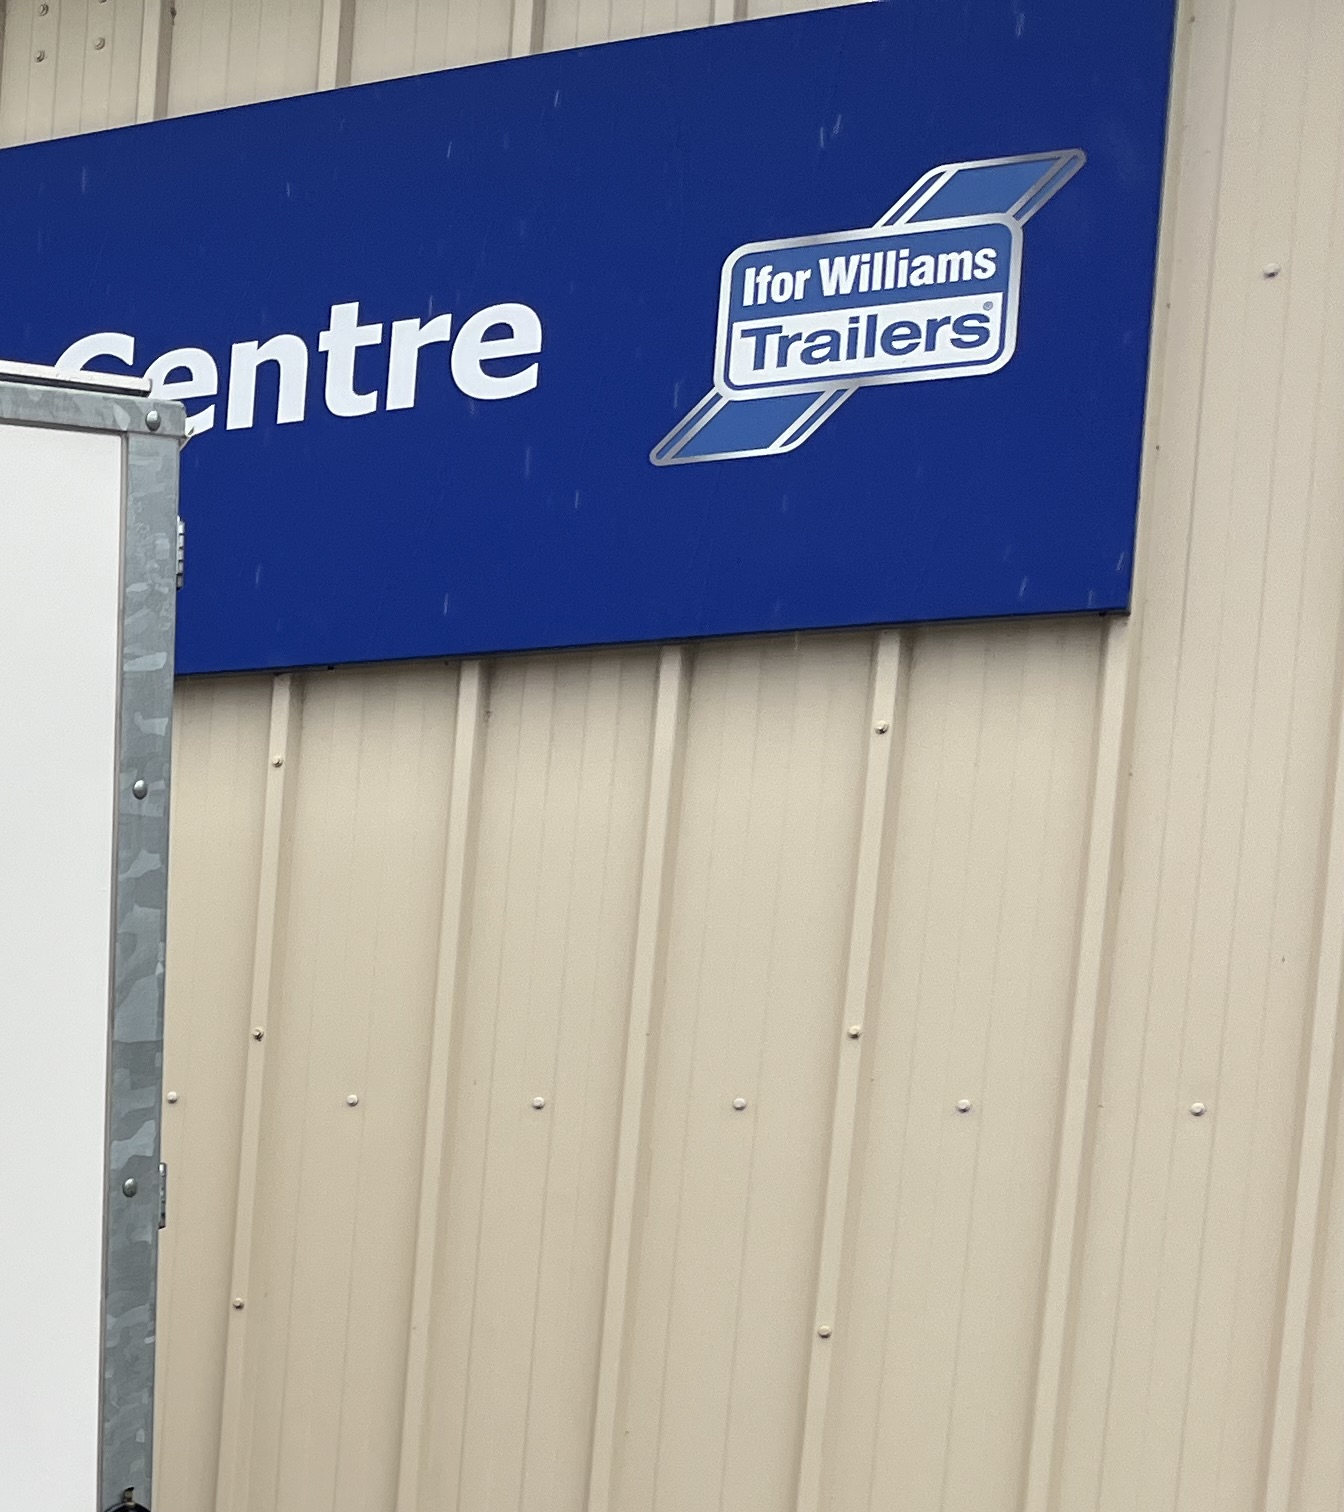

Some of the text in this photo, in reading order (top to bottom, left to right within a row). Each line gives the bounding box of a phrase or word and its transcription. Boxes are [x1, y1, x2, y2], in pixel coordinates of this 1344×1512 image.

[742, 247, 998, 307] Ifor Williams
[739, 312, 992, 372] Trailers
